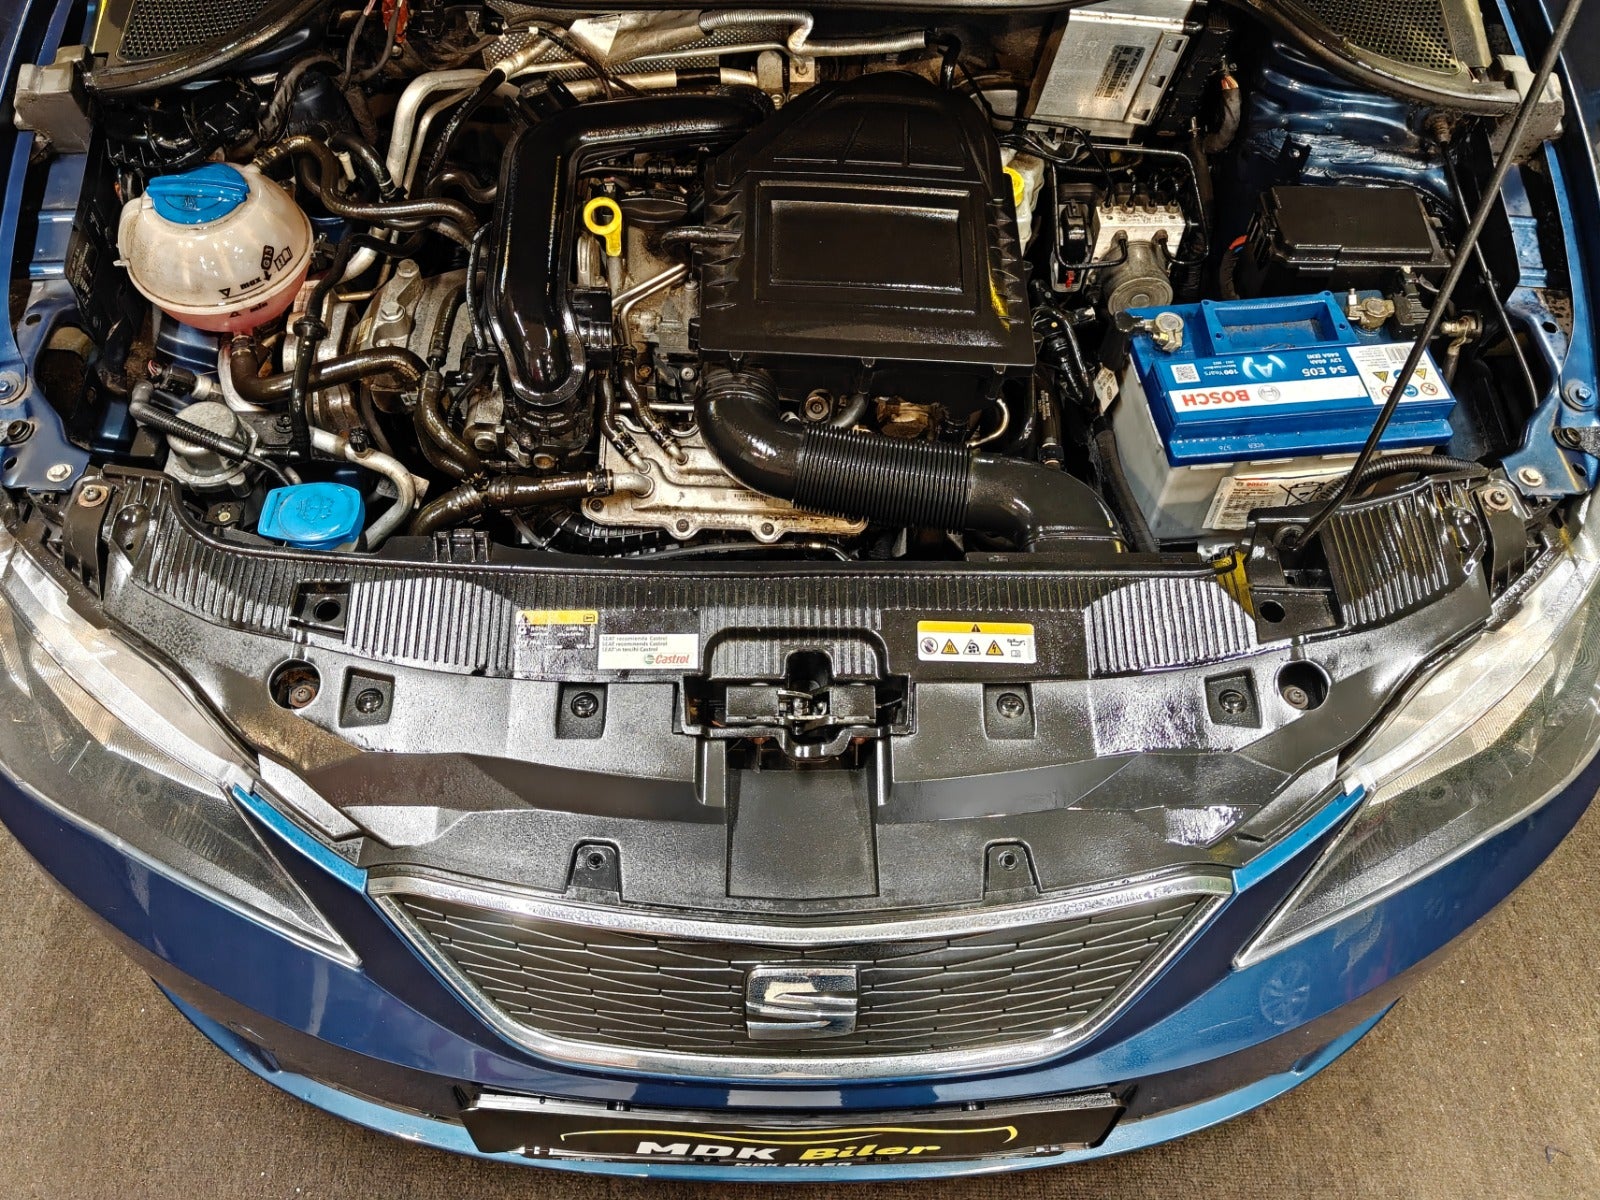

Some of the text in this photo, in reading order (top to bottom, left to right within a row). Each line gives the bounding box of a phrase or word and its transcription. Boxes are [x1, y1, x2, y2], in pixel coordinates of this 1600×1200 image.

[240, 277, 261, 290] max
[250, 301, 268, 312] min
[1301, 365, 1347, 377] S4 E05
[1181, 389, 1250, 407] BOSCH
[655, 654, 690, 664] Castrol
[636, 1141, 941, 1160] MDK Biler
